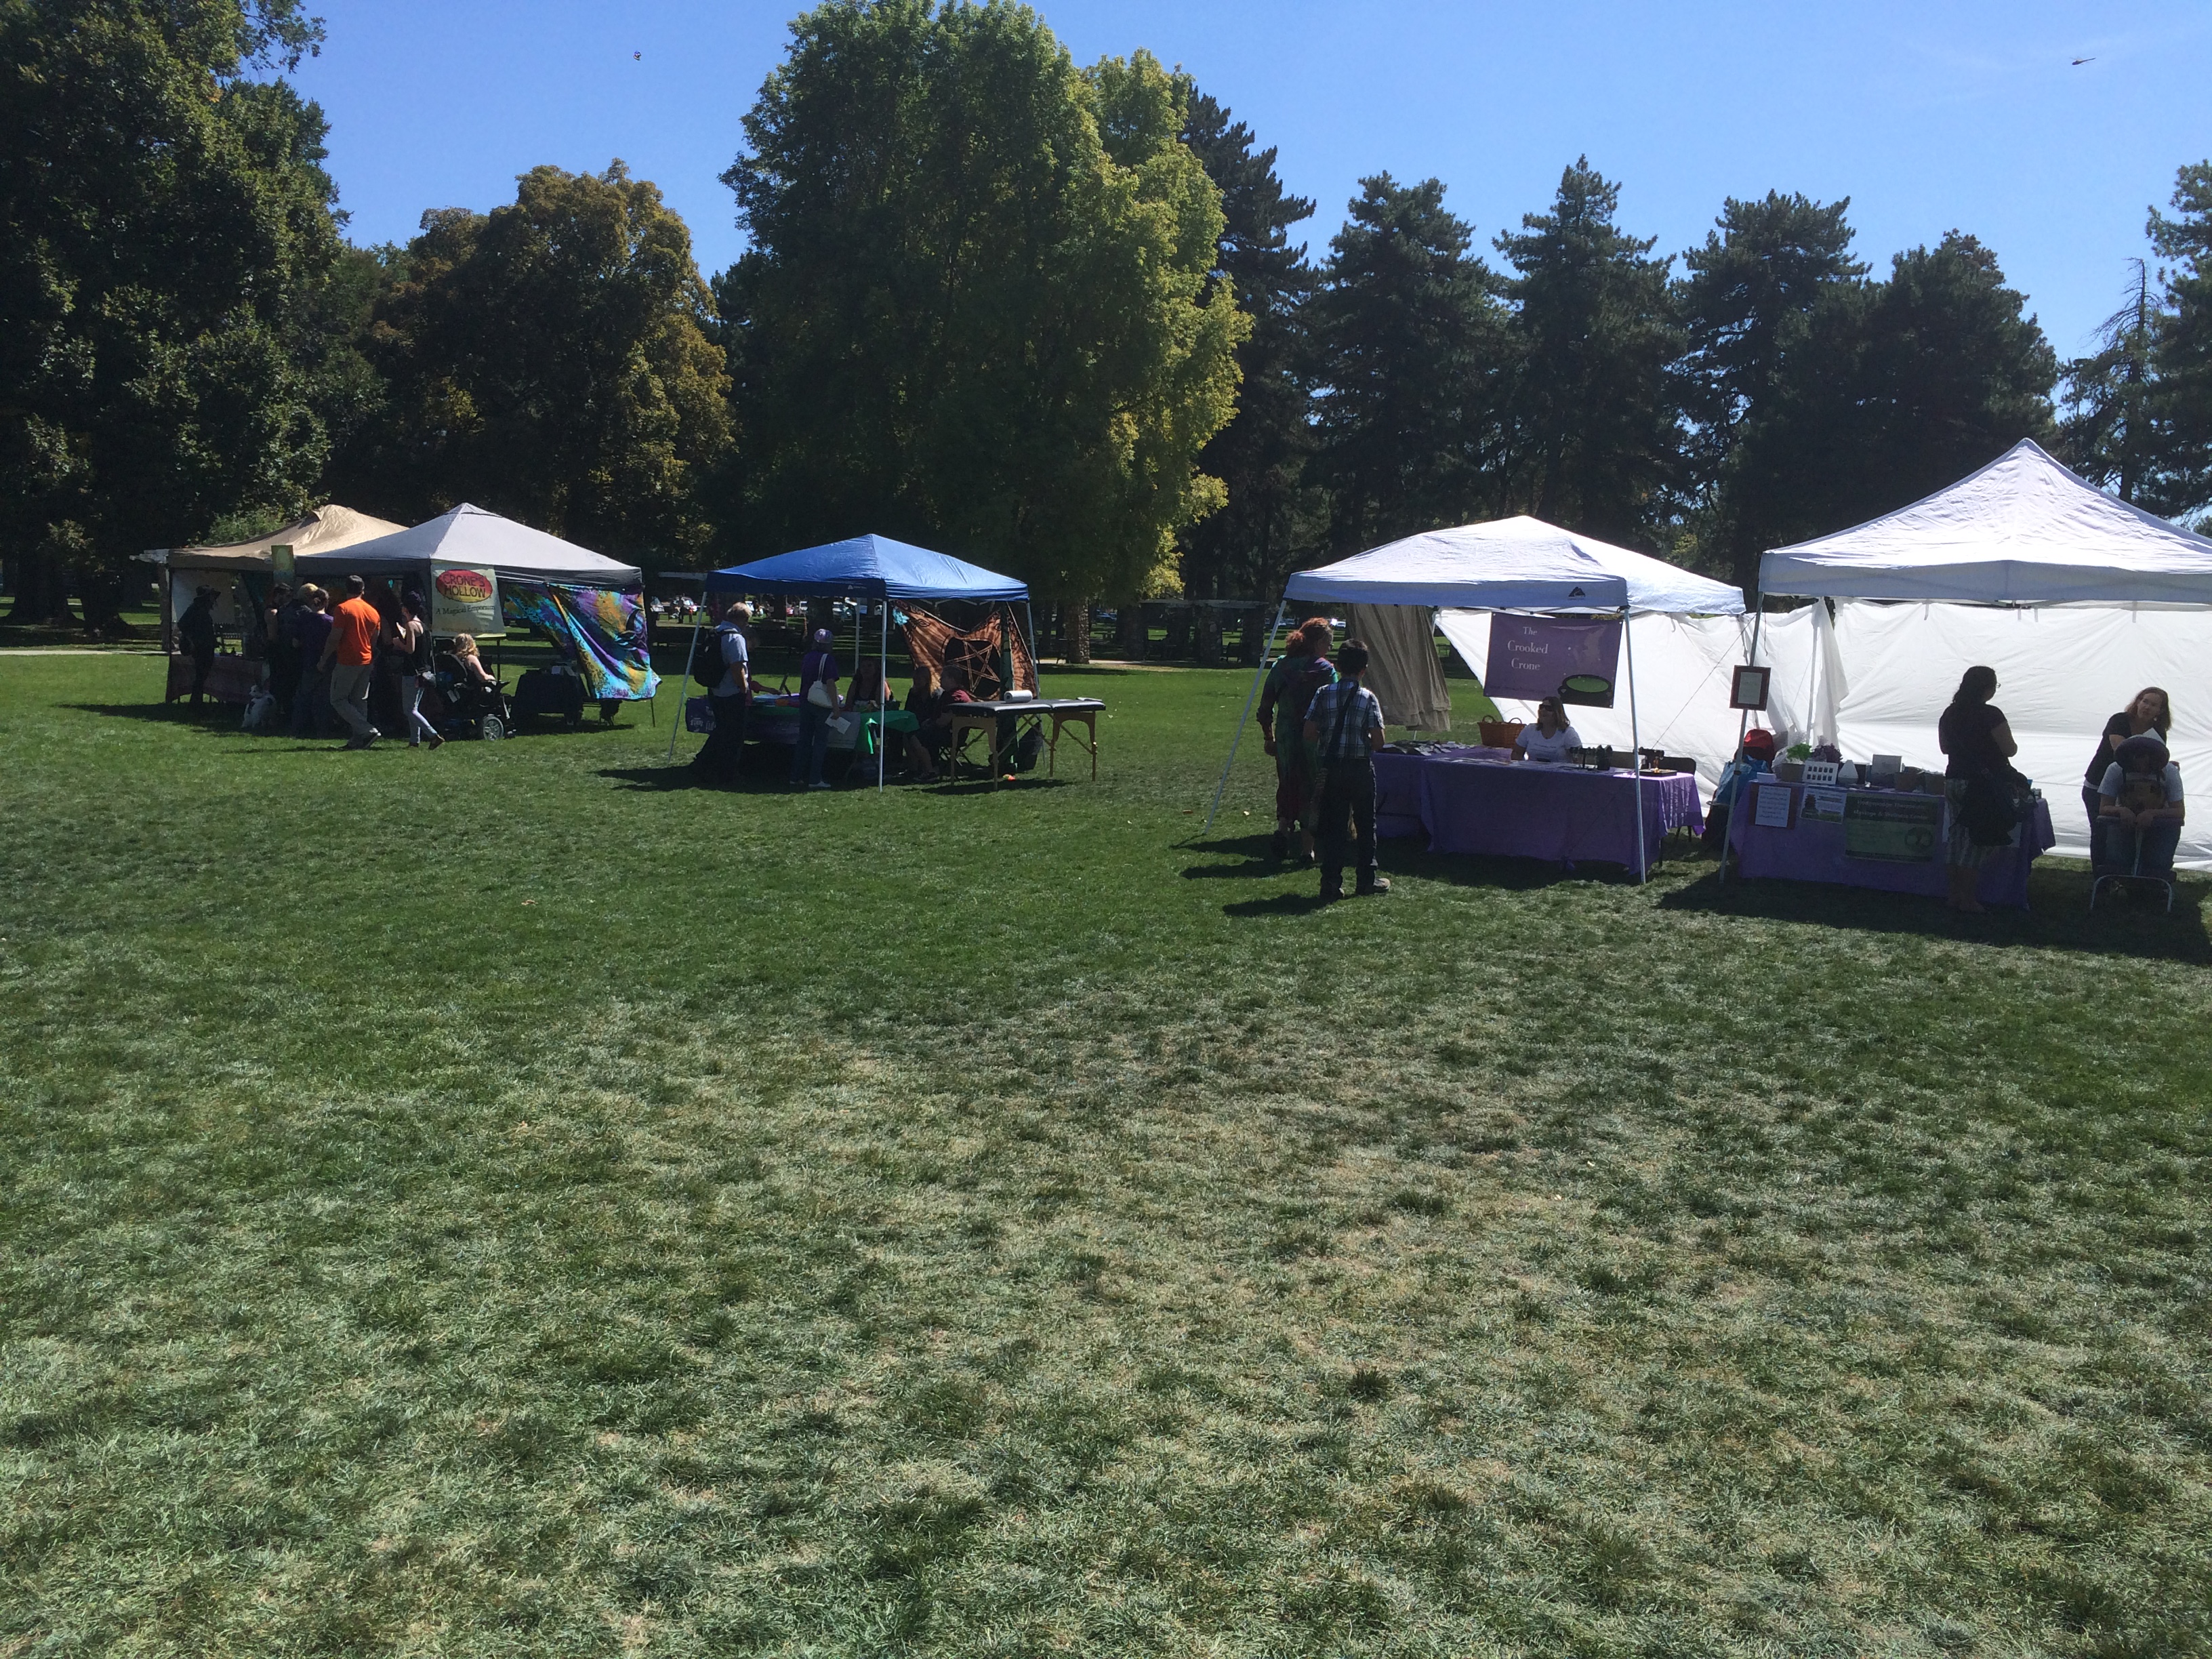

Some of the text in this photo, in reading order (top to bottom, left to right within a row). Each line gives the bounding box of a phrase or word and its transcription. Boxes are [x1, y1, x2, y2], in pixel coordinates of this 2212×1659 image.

[443, 574, 485, 587] CRONE'S
[444, 585, 486, 598] HOLLOW
[442, 605, 466, 616] Magical
[1522, 626, 1538, 636] The
[1507, 640, 1549, 655] Crooked
[1511, 657, 1541, 671] Crone
